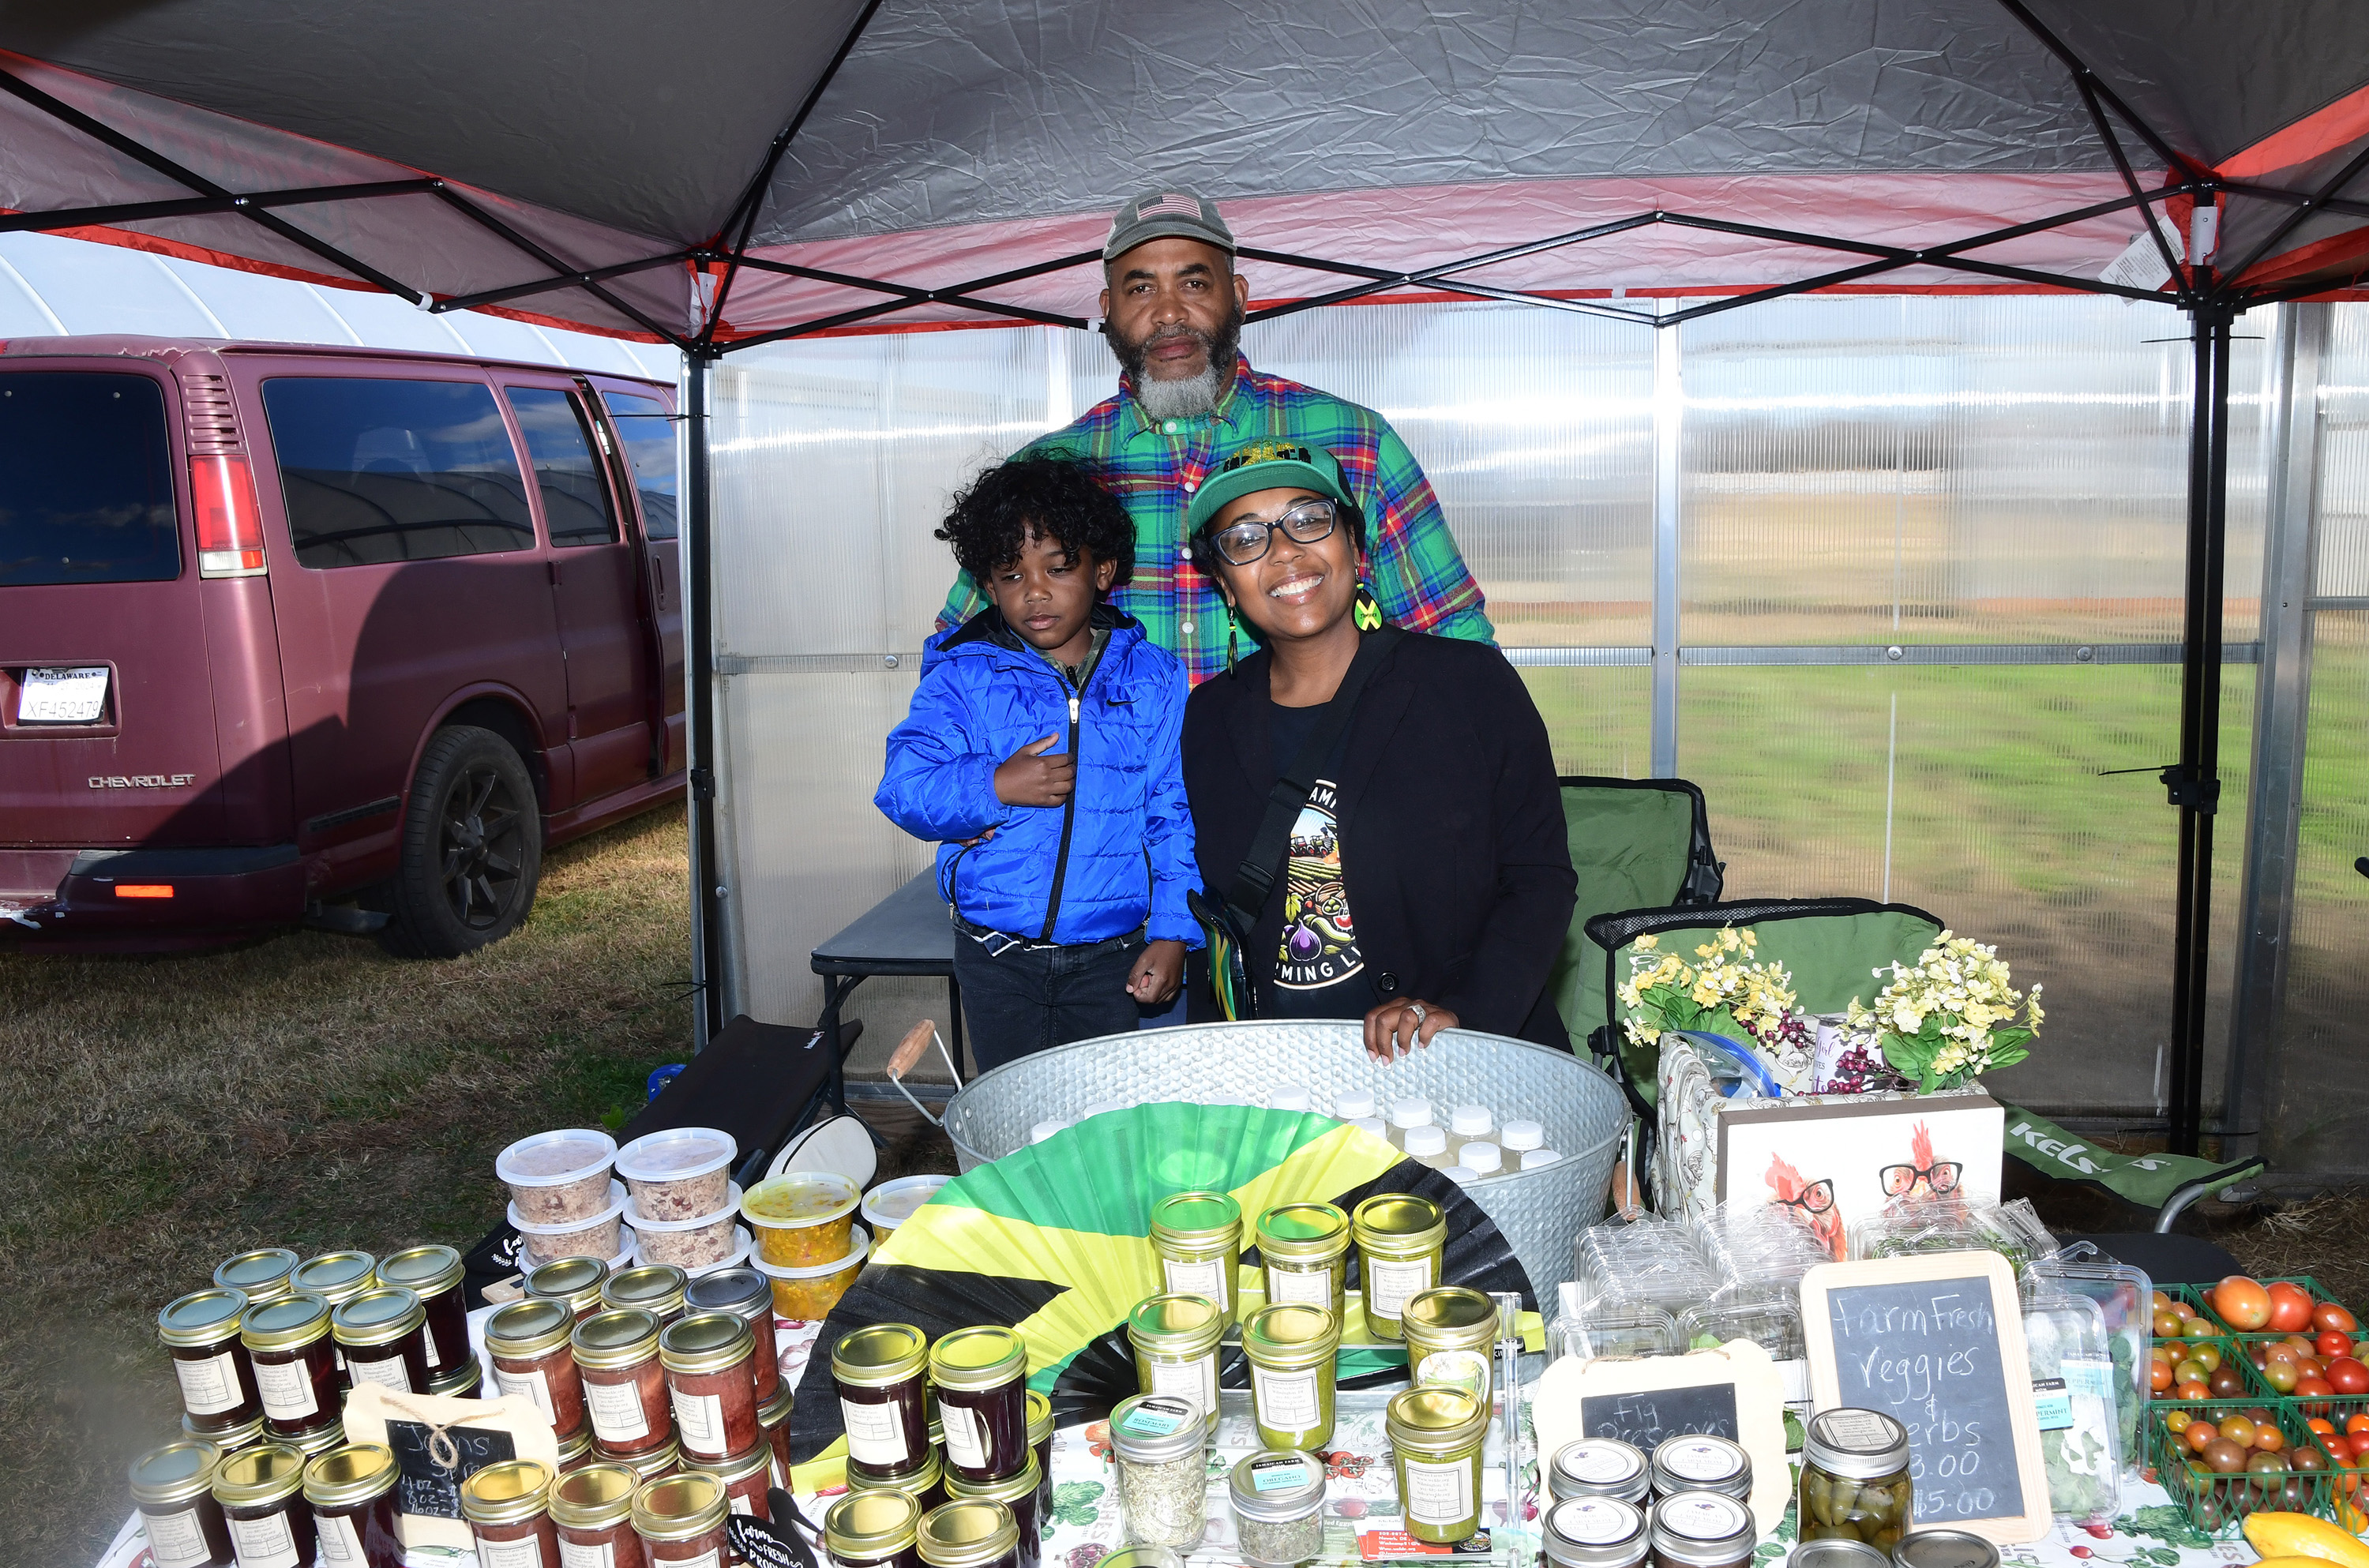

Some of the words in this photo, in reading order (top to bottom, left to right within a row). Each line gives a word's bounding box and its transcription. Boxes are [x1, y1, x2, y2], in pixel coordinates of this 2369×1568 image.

[88, 774, 195, 789] CHEVROLET
[1275, 962, 1334, 984] MING
[1932, 1294, 1992, 1334] Fresh
[1853, 1345, 1979, 1404] Veggies
[1134, 1418, 1170, 1427] ROSEMARY
[1613, 1394, 1662, 1432] Fig
[1902, 1409, 1980, 1447] erbs
[1913, 1487, 1995, 1518] $5.00
[736, 1518, 778, 1546] farm
[763, 1544, 790, 1566] FRESH
